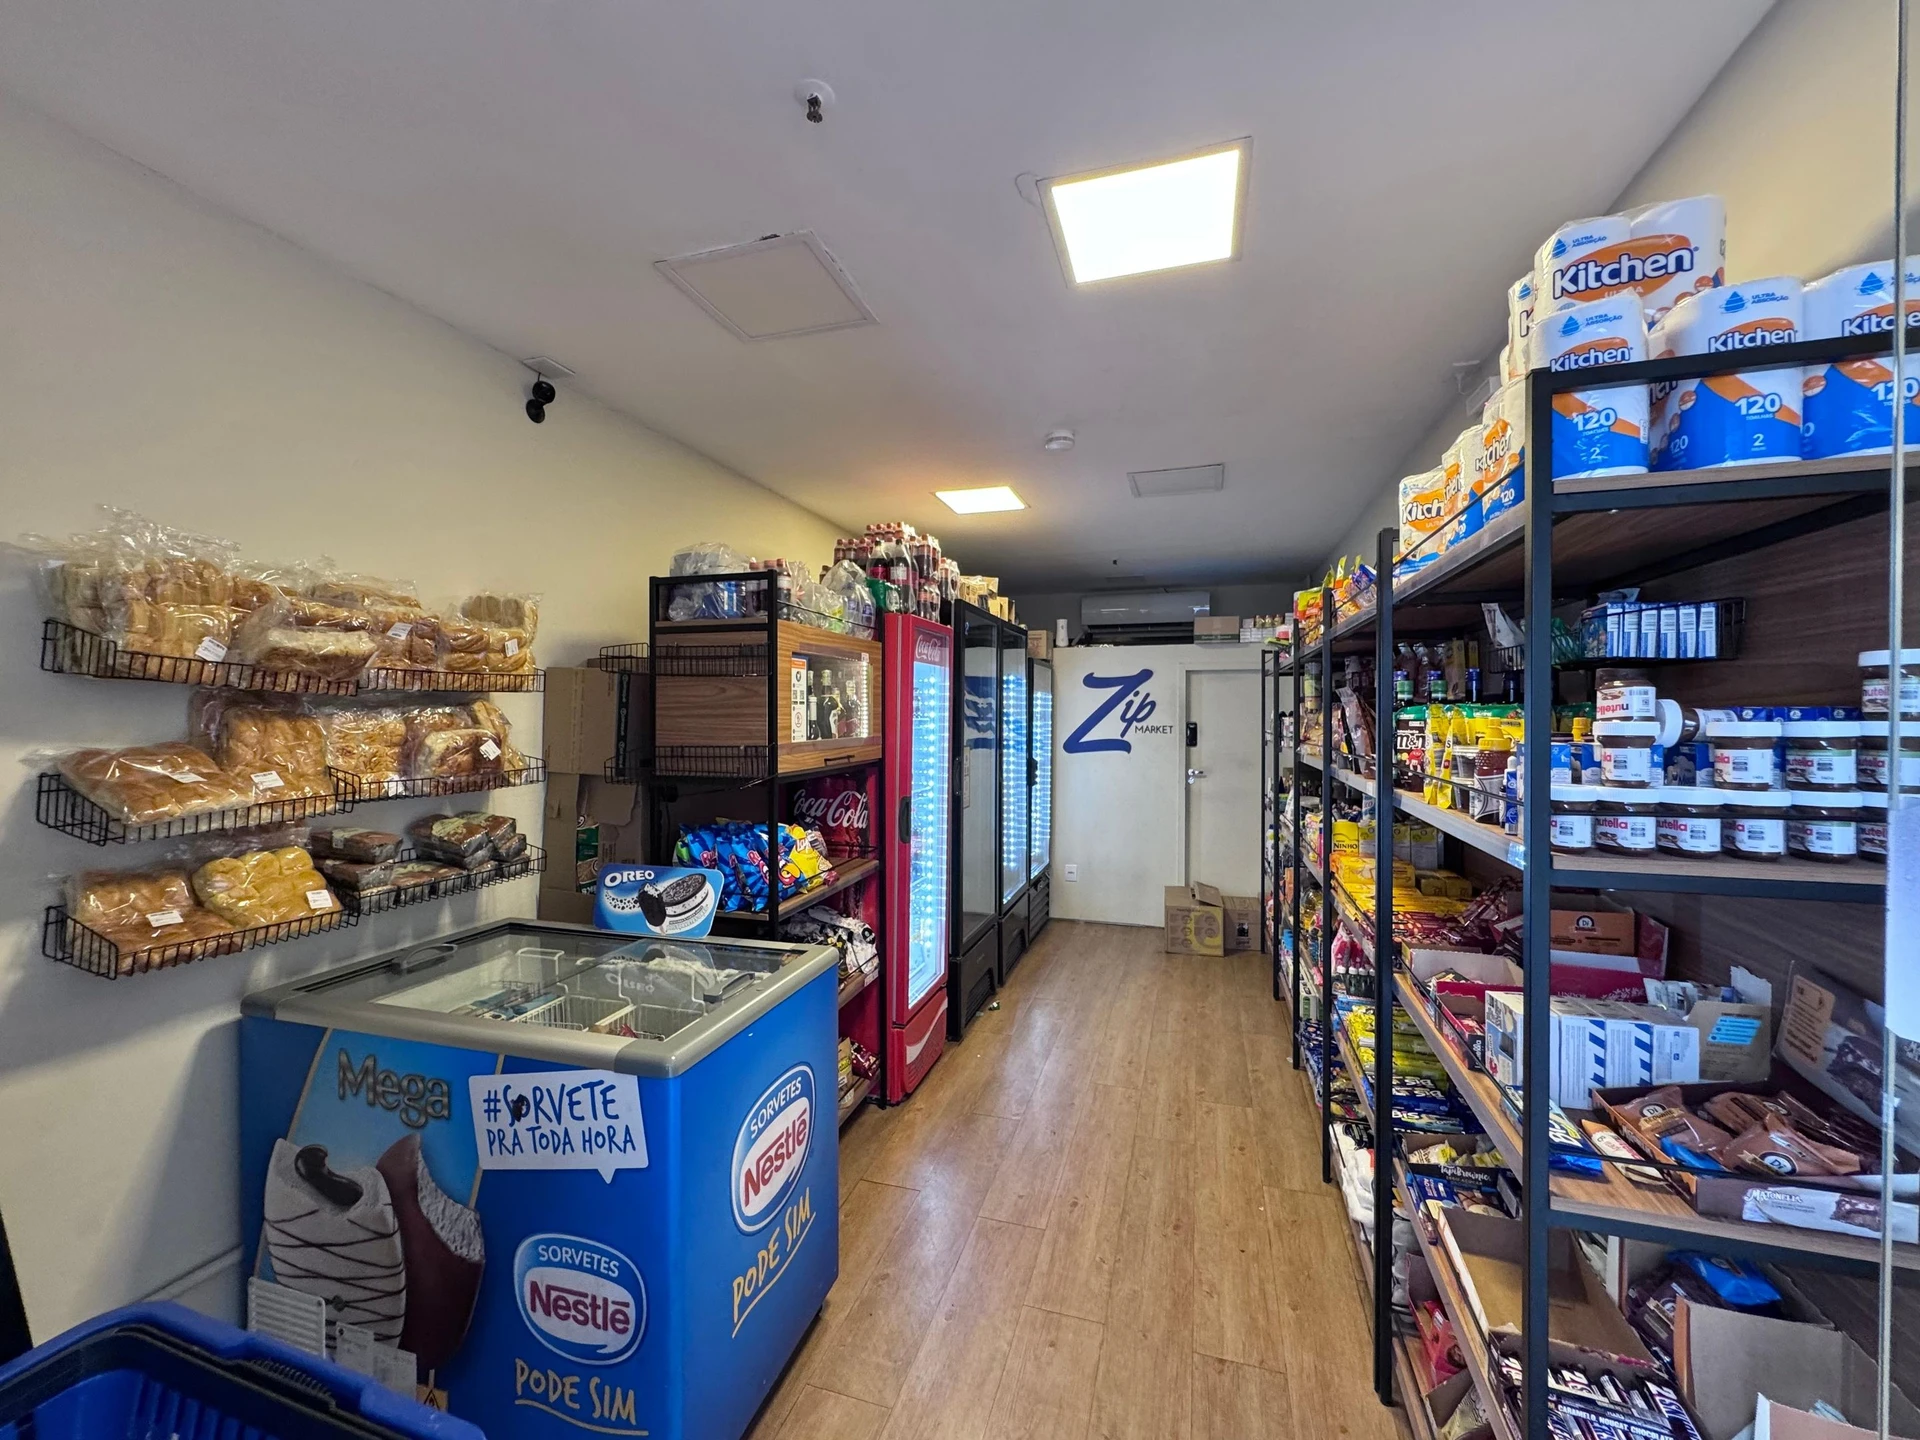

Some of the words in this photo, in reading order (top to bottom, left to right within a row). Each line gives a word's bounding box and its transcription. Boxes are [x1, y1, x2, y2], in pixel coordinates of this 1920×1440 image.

[1553, 247, 1694, 300] Kitchen
[1708, 327, 1797, 353] Kitchen
[1550, 347, 1631, 373] Kitchen
[1572, 408, 1618, 432] 120
[1734, 393, 1782, 416] 120
[1589, 447, 1601, 459] 2
[1752, 433, 1765, 446] 2
[1501, 488, 1515, 503] 120
[1062, 668, 1157, 754] Zip
[1134, 725, 1174, 735] MARKET
[1333, 842, 1359, 850] NINHO
[604, 870, 655, 888] OREO
[338, 1047, 450, 1129] Mega
[483, 1079, 620, 1127] #SORVETE
[750, 1076, 802, 1139] SORVETES
[486, 1128, 524, 1156] PRA
[525, 1125, 574, 1155] TODA
[581, 1125, 636, 1155] HORA
[744, 1107, 808, 1207] Nestlé
[538, 1245, 620, 1278] SORVETES
[732, 1226, 781, 1324] PODE
[784, 1187, 811, 1252] SIM
[529, 1280, 631, 1335] Nestlé
[514, 1357, 581, 1410] PODE
[589, 1376, 637, 1426] SIM
